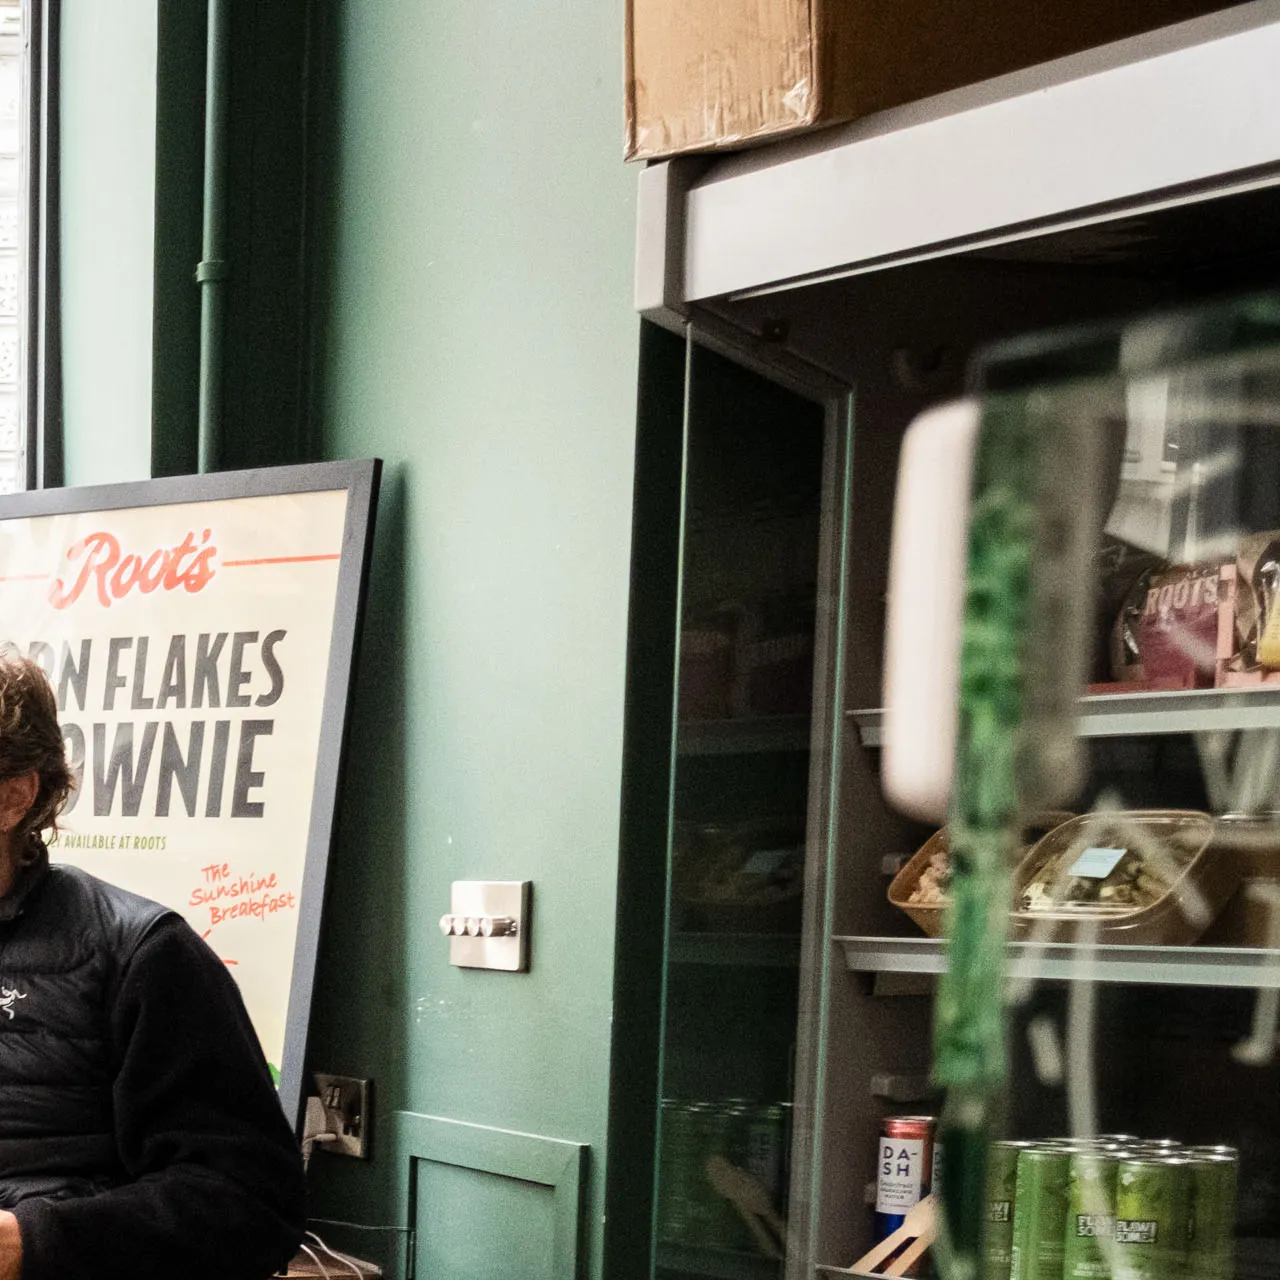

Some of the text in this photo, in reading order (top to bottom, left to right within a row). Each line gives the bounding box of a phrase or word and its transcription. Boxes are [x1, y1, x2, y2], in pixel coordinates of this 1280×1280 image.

[102, 629, 288, 711] FLAKES
[64, 834, 116, 849] AVAILABLE
[118, 835, 130, 850] AT
[133, 836, 167, 851] ROOTS
[188, 872, 279, 907] Sunshine
[201, 863, 230, 884] The
[209, 891, 296, 926] Breakfast
